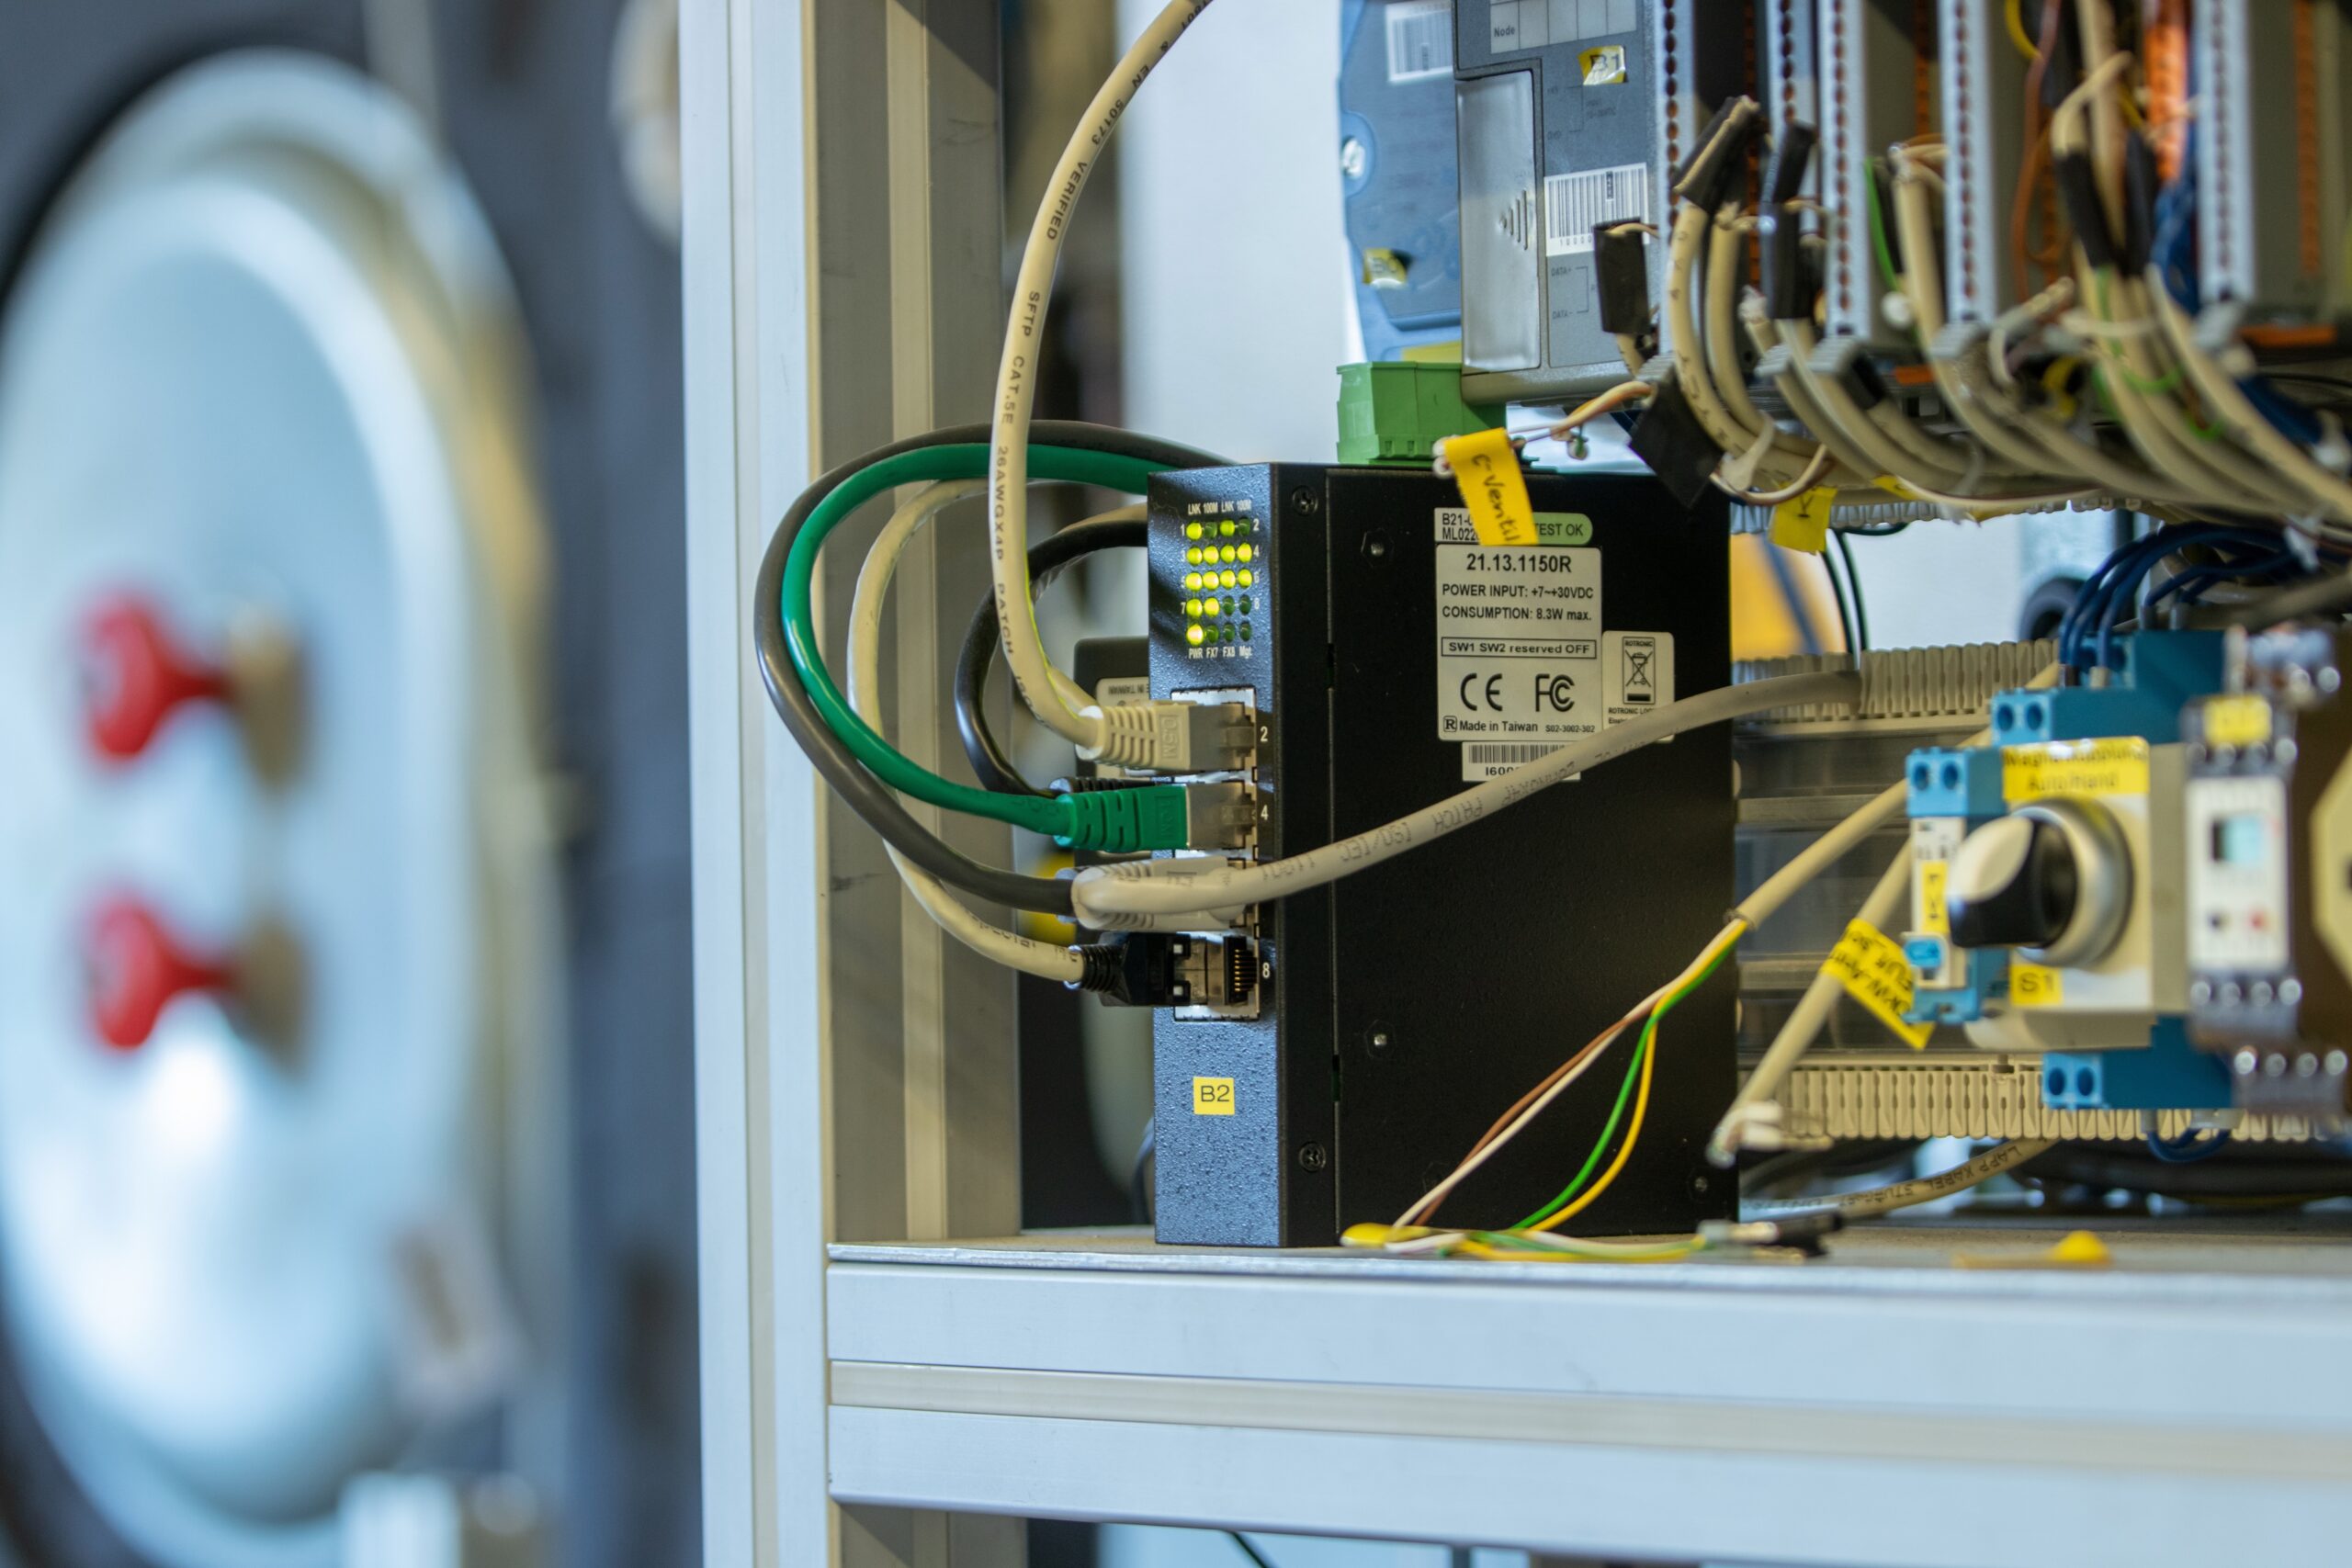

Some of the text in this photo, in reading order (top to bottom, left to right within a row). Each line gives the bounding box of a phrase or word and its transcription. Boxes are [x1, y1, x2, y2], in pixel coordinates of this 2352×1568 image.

[1494, 25, 1515, 38] Node
[1132, 64, 1149, 88] EN
[1091, 99, 1124, 145] 50173
[1046, 161, 1088, 241] VERIFIED
[1023, 290, 1041, 337] SFTP
[1001, 355, 1024, 424] CAT.5E
[1188, 503, 1201, 514] LNK
[1221, 500, 1234, 513] LNK
[1181, 518, 1260, 536] 1 2
[1566, 524, 1584, 536] OK
[1253, 545, 1260, 558] 4
[1466, 553, 1572, 573] 21.13.1150R
[1442, 583, 1487, 596] POWER
[1489, 584, 1528, 597] INPUT:
[1181, 597, 1260, 615] 7 8
[1442, 605, 1592, 621] CONSUMPTION: 8.3W max.
[997, 582, 1014, 655] PATCH
[1188, 648, 1203, 659] PWR
[1206, 647, 1218, 658] FX7
[1449, 642, 1590, 654] SW1 SW2 reserved OFF
[1460, 672, 1503, 712] CE
[1260, 727, 1268, 742] 2
[1459, 721, 1487, 732] Made
[1489, 721, 1498, 732] in
[1502, 721, 1538, 732] Taiwan
[1545, 724, 1596, 733] S02-3002-302
[1261, 805, 1269, 821] 4
[1261, 962, 1270, 978] 8
[2020, 972, 2054, 992] S1
[1201, 1085, 1230, 1103] B2
